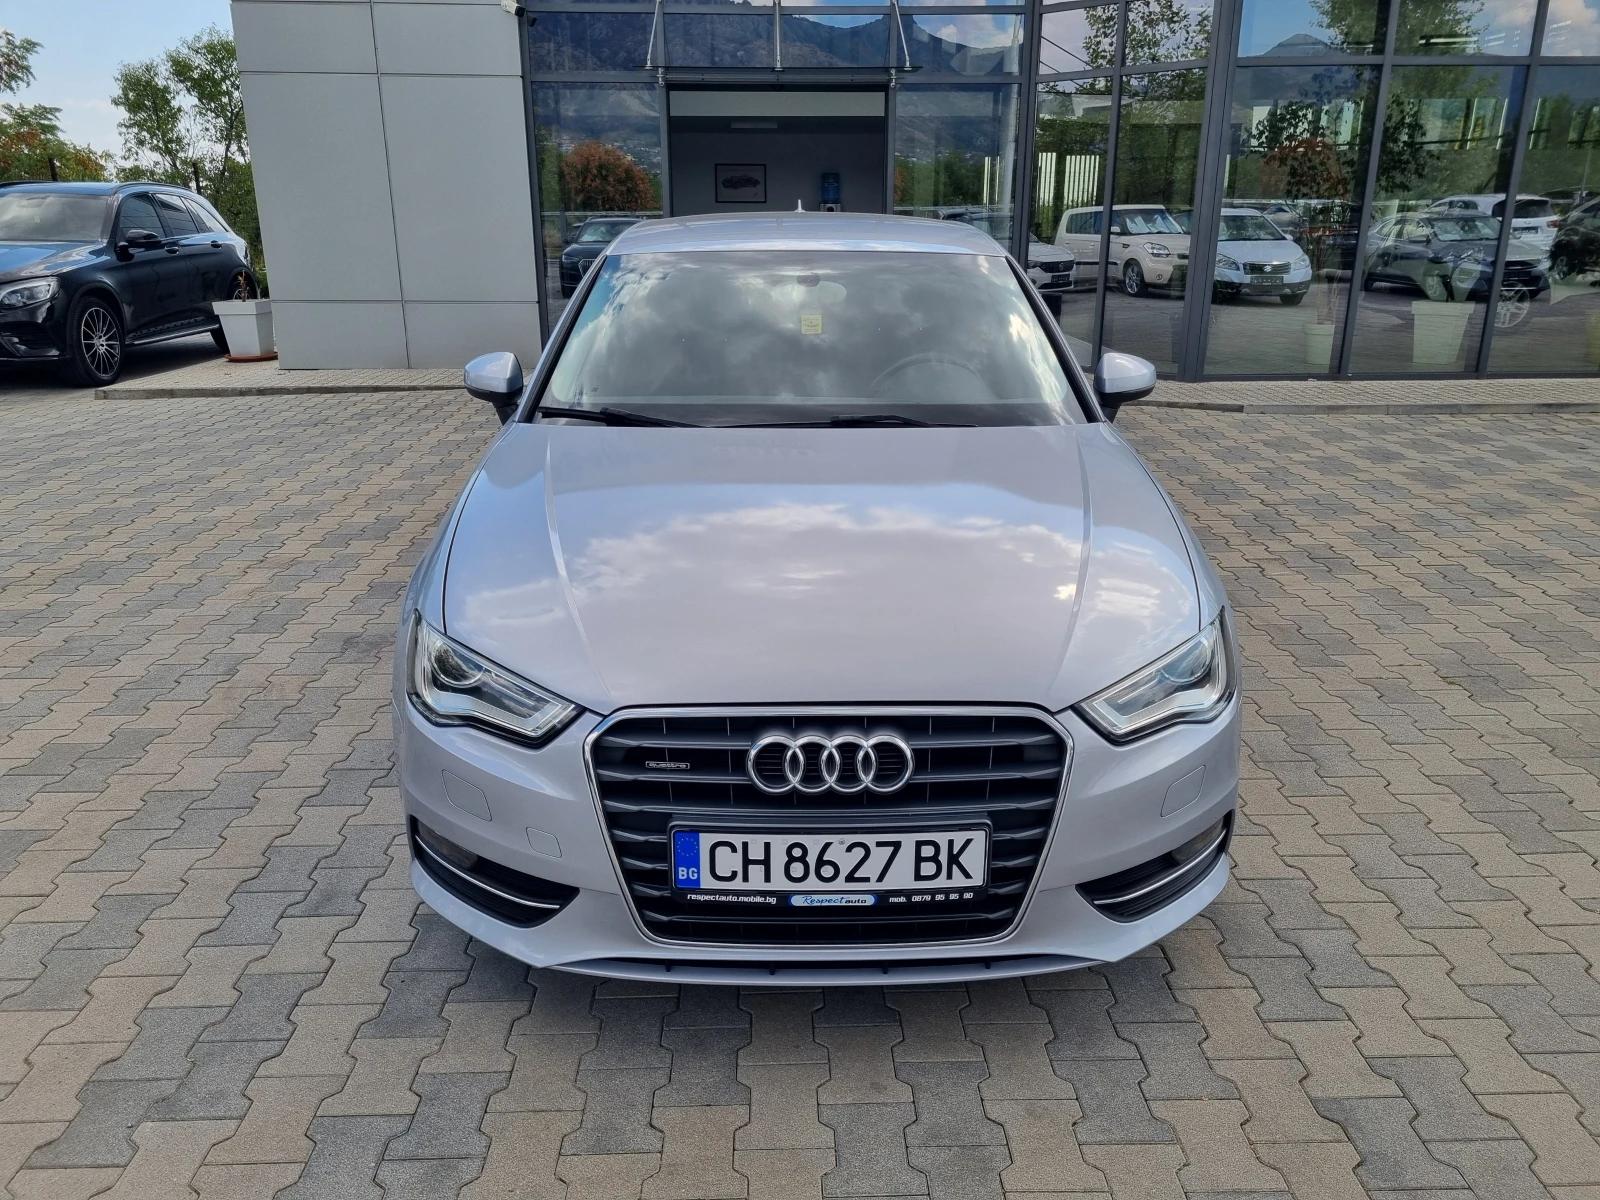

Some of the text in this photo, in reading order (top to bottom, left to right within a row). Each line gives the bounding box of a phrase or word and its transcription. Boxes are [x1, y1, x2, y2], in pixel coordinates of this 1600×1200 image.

[709, 837, 975, 883] CH 8627 BK
[678, 867, 698, 880] BG
[687, 893, 777, 904] respectauto.mobile.bg
[801, 895, 849, 905] Respect
